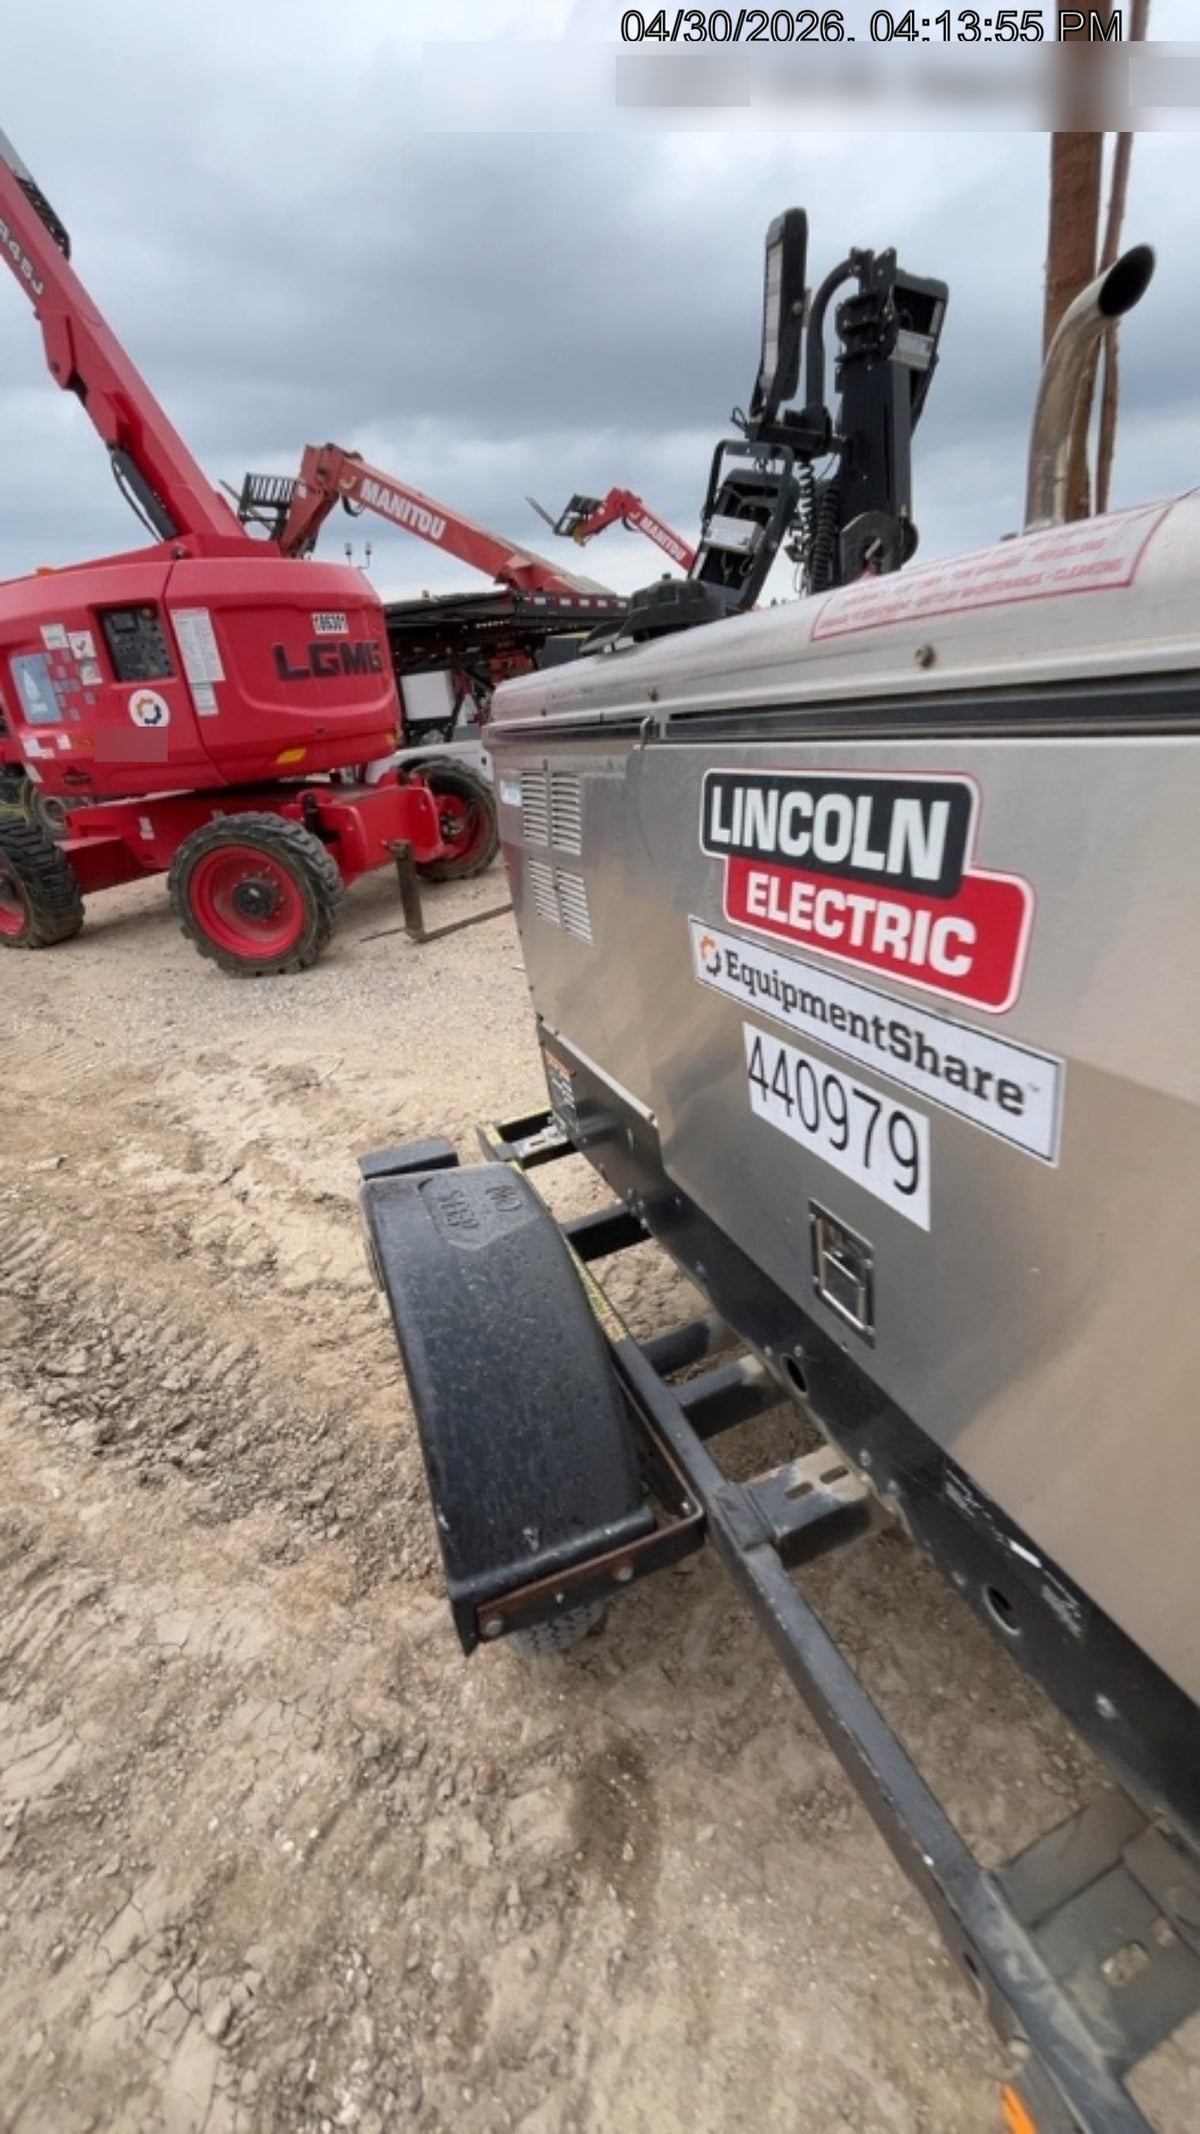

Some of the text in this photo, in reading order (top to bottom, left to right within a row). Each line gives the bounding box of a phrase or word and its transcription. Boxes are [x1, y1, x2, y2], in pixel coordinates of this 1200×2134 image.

[360, 477, 447, 541] MANITOU
[274, 640, 382, 680] LGMG
[710, 784, 952, 881] LINCOLN
[746, 870, 977, 977] ELECTRIC
[724, 948, 1025, 1118] EquipmentShare
[748, 1035, 920, 1196] 440979
